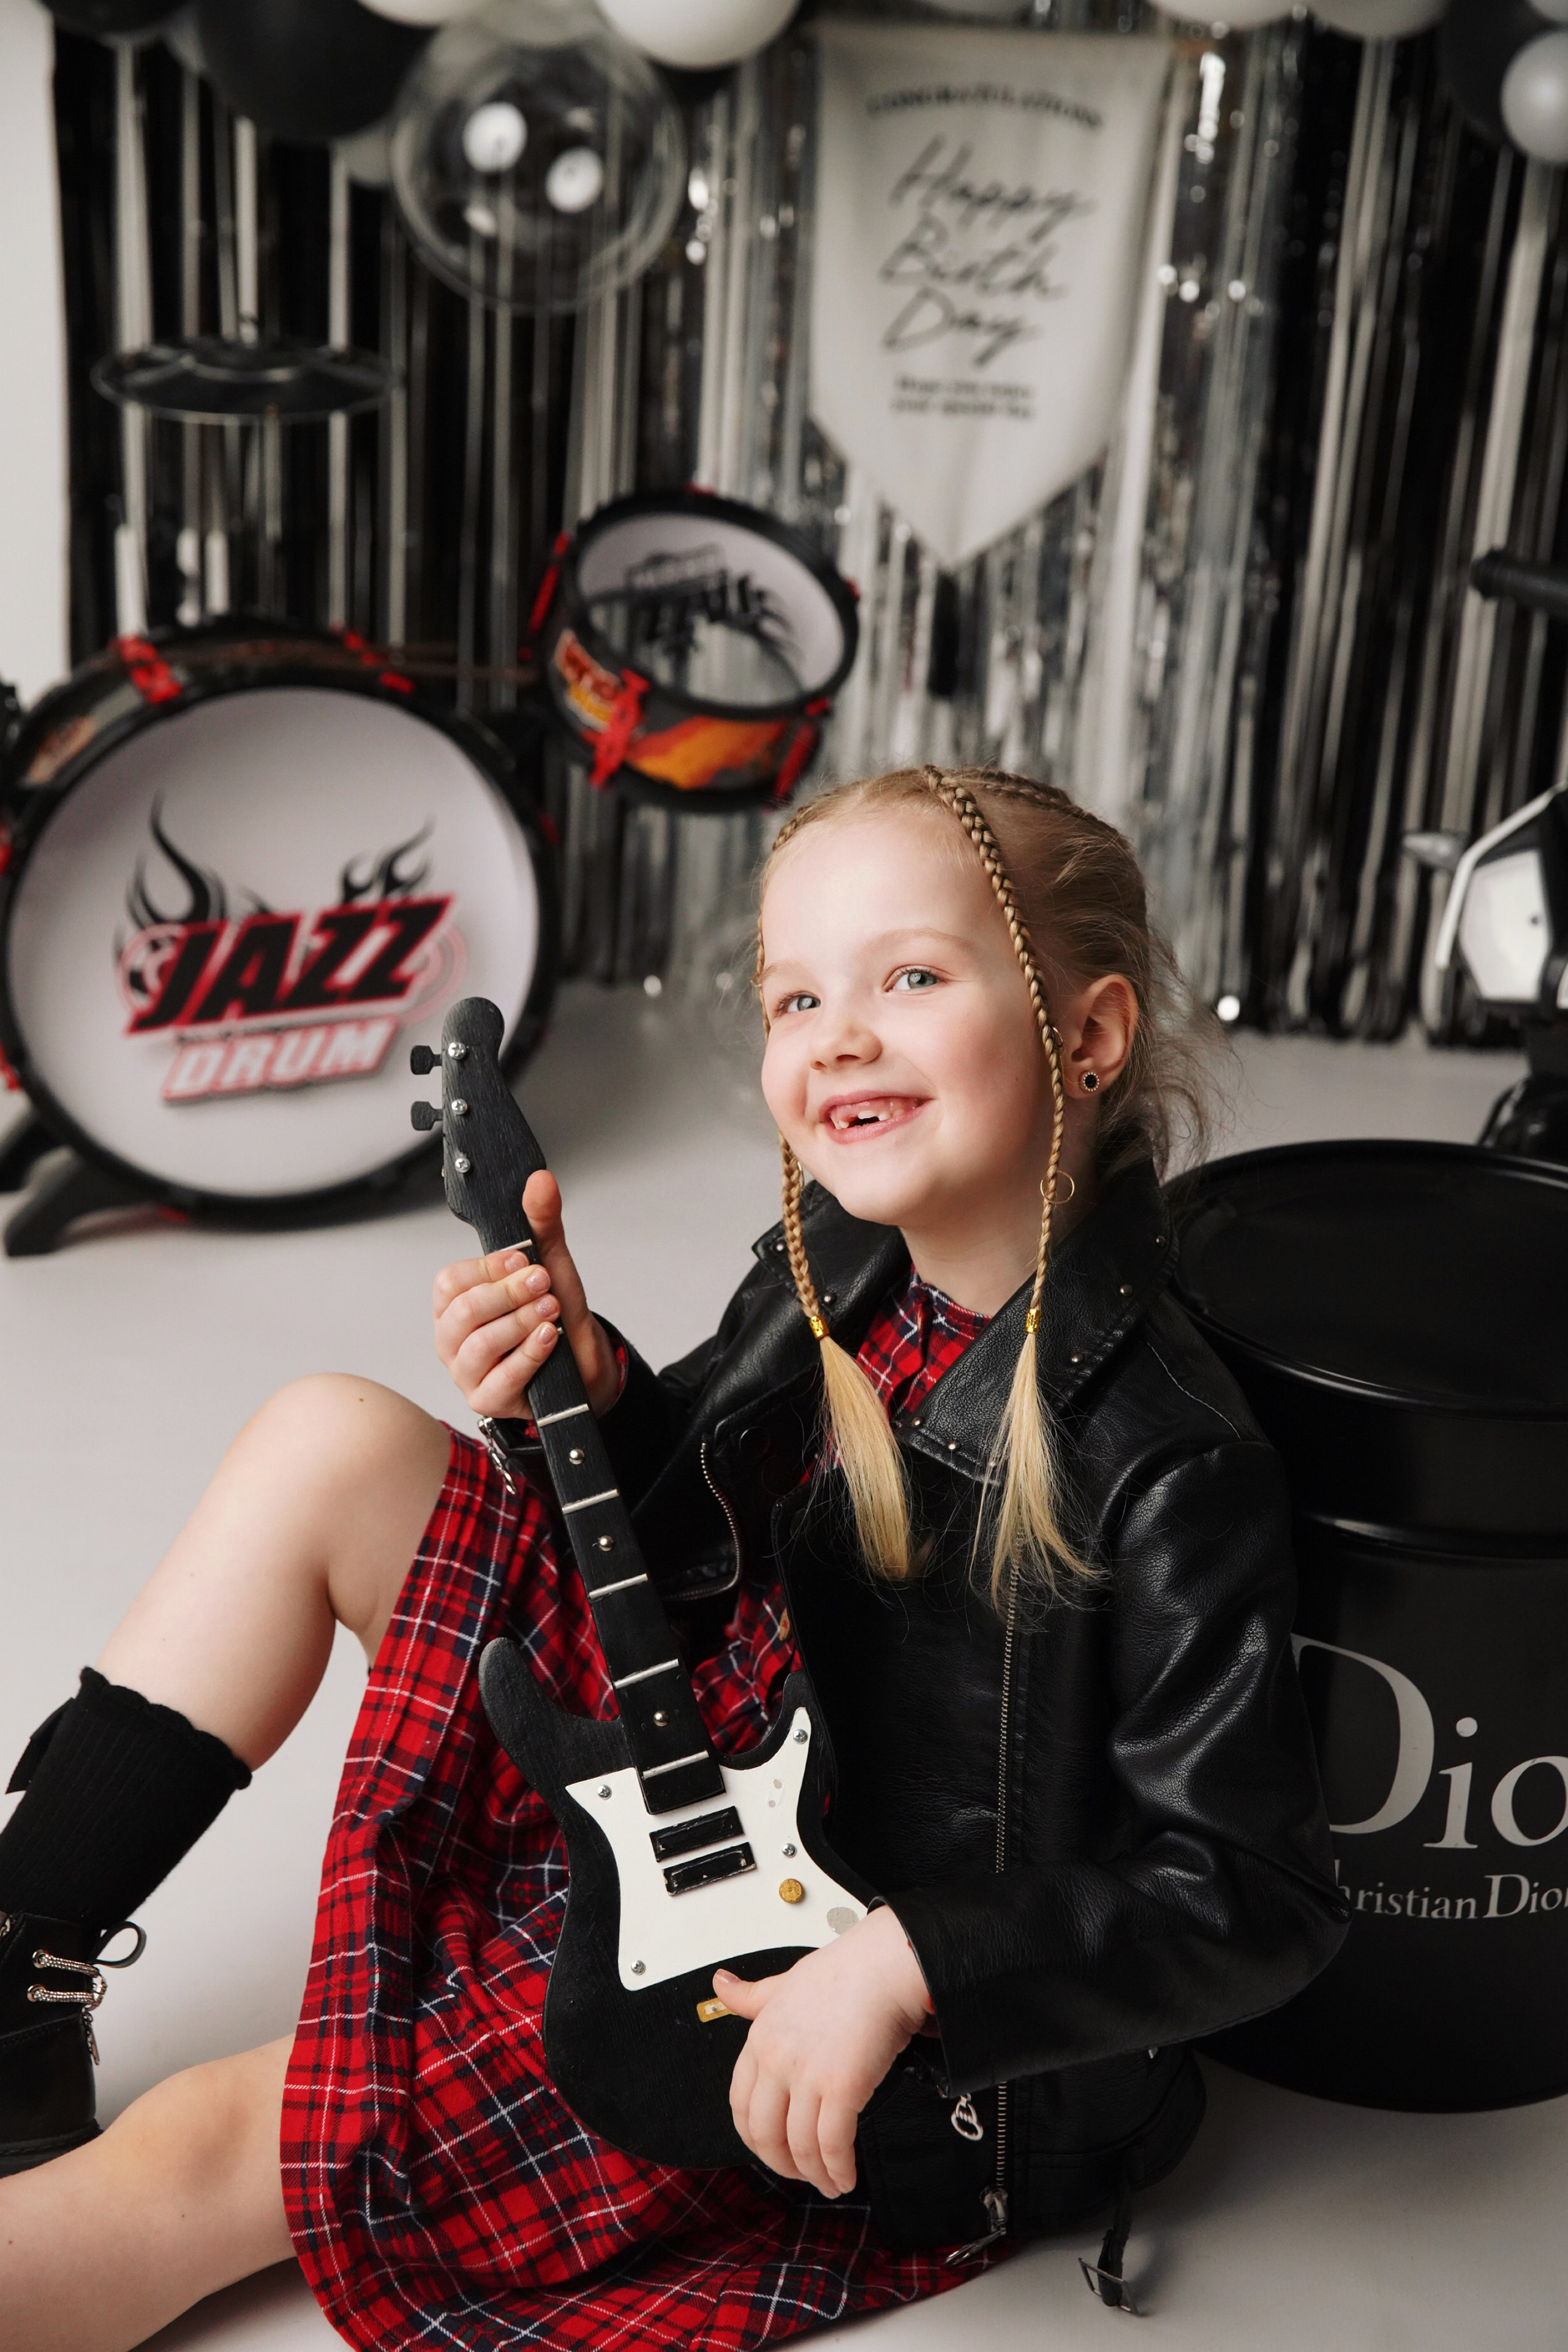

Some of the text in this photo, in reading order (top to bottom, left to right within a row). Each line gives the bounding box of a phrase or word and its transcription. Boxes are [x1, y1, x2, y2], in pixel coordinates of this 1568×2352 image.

[888, 135, 1096, 244] Happy
[882, 285, 1040, 369] Day
[126, 895, 452, 1033] JAZZ
[162, 1018, 398, 1101] DRUM
[1291, 1633, 1568, 1848] Dio
